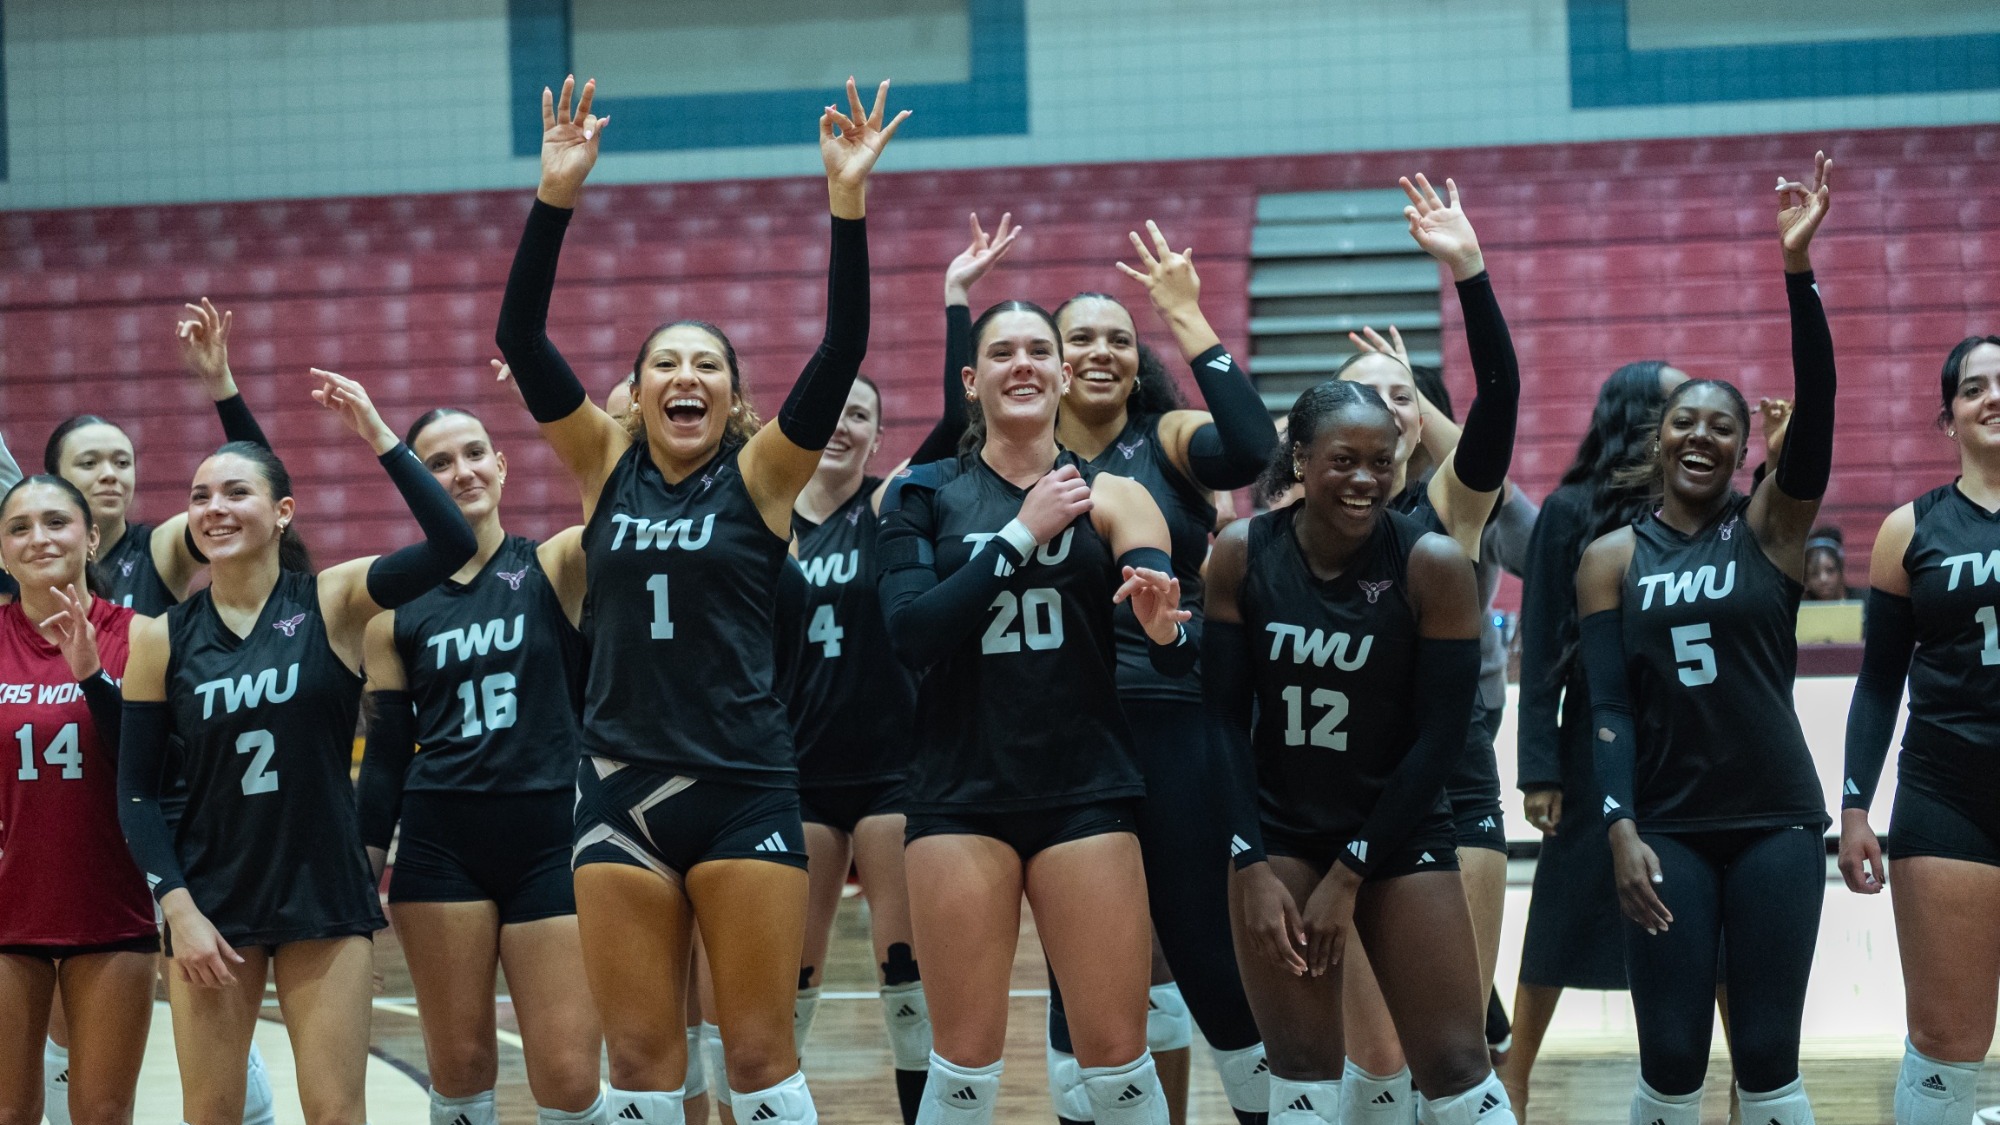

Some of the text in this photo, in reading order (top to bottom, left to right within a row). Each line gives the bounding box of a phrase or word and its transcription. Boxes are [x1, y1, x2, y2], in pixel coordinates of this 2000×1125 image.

[611, 513, 716, 551] TWU
[962, 526, 1075, 566] TU
[1637, 560, 1736, 611] TWU
[1940, 549, 2000, 592] TW
[646, 573, 674, 640] 1
[807, 603, 844, 659] 4
[981, 587, 1064, 655] 20
[426, 613, 525, 670] TWU
[1265, 621, 1375, 672] TWU
[1670, 622, 1718, 687] 5
[194, 662, 300, 720] TWU
[456, 671, 518, 738] 16
[1281, 685, 1350, 752] 12
[14, 722, 83, 781] 14
[235, 728, 279, 796] 2
